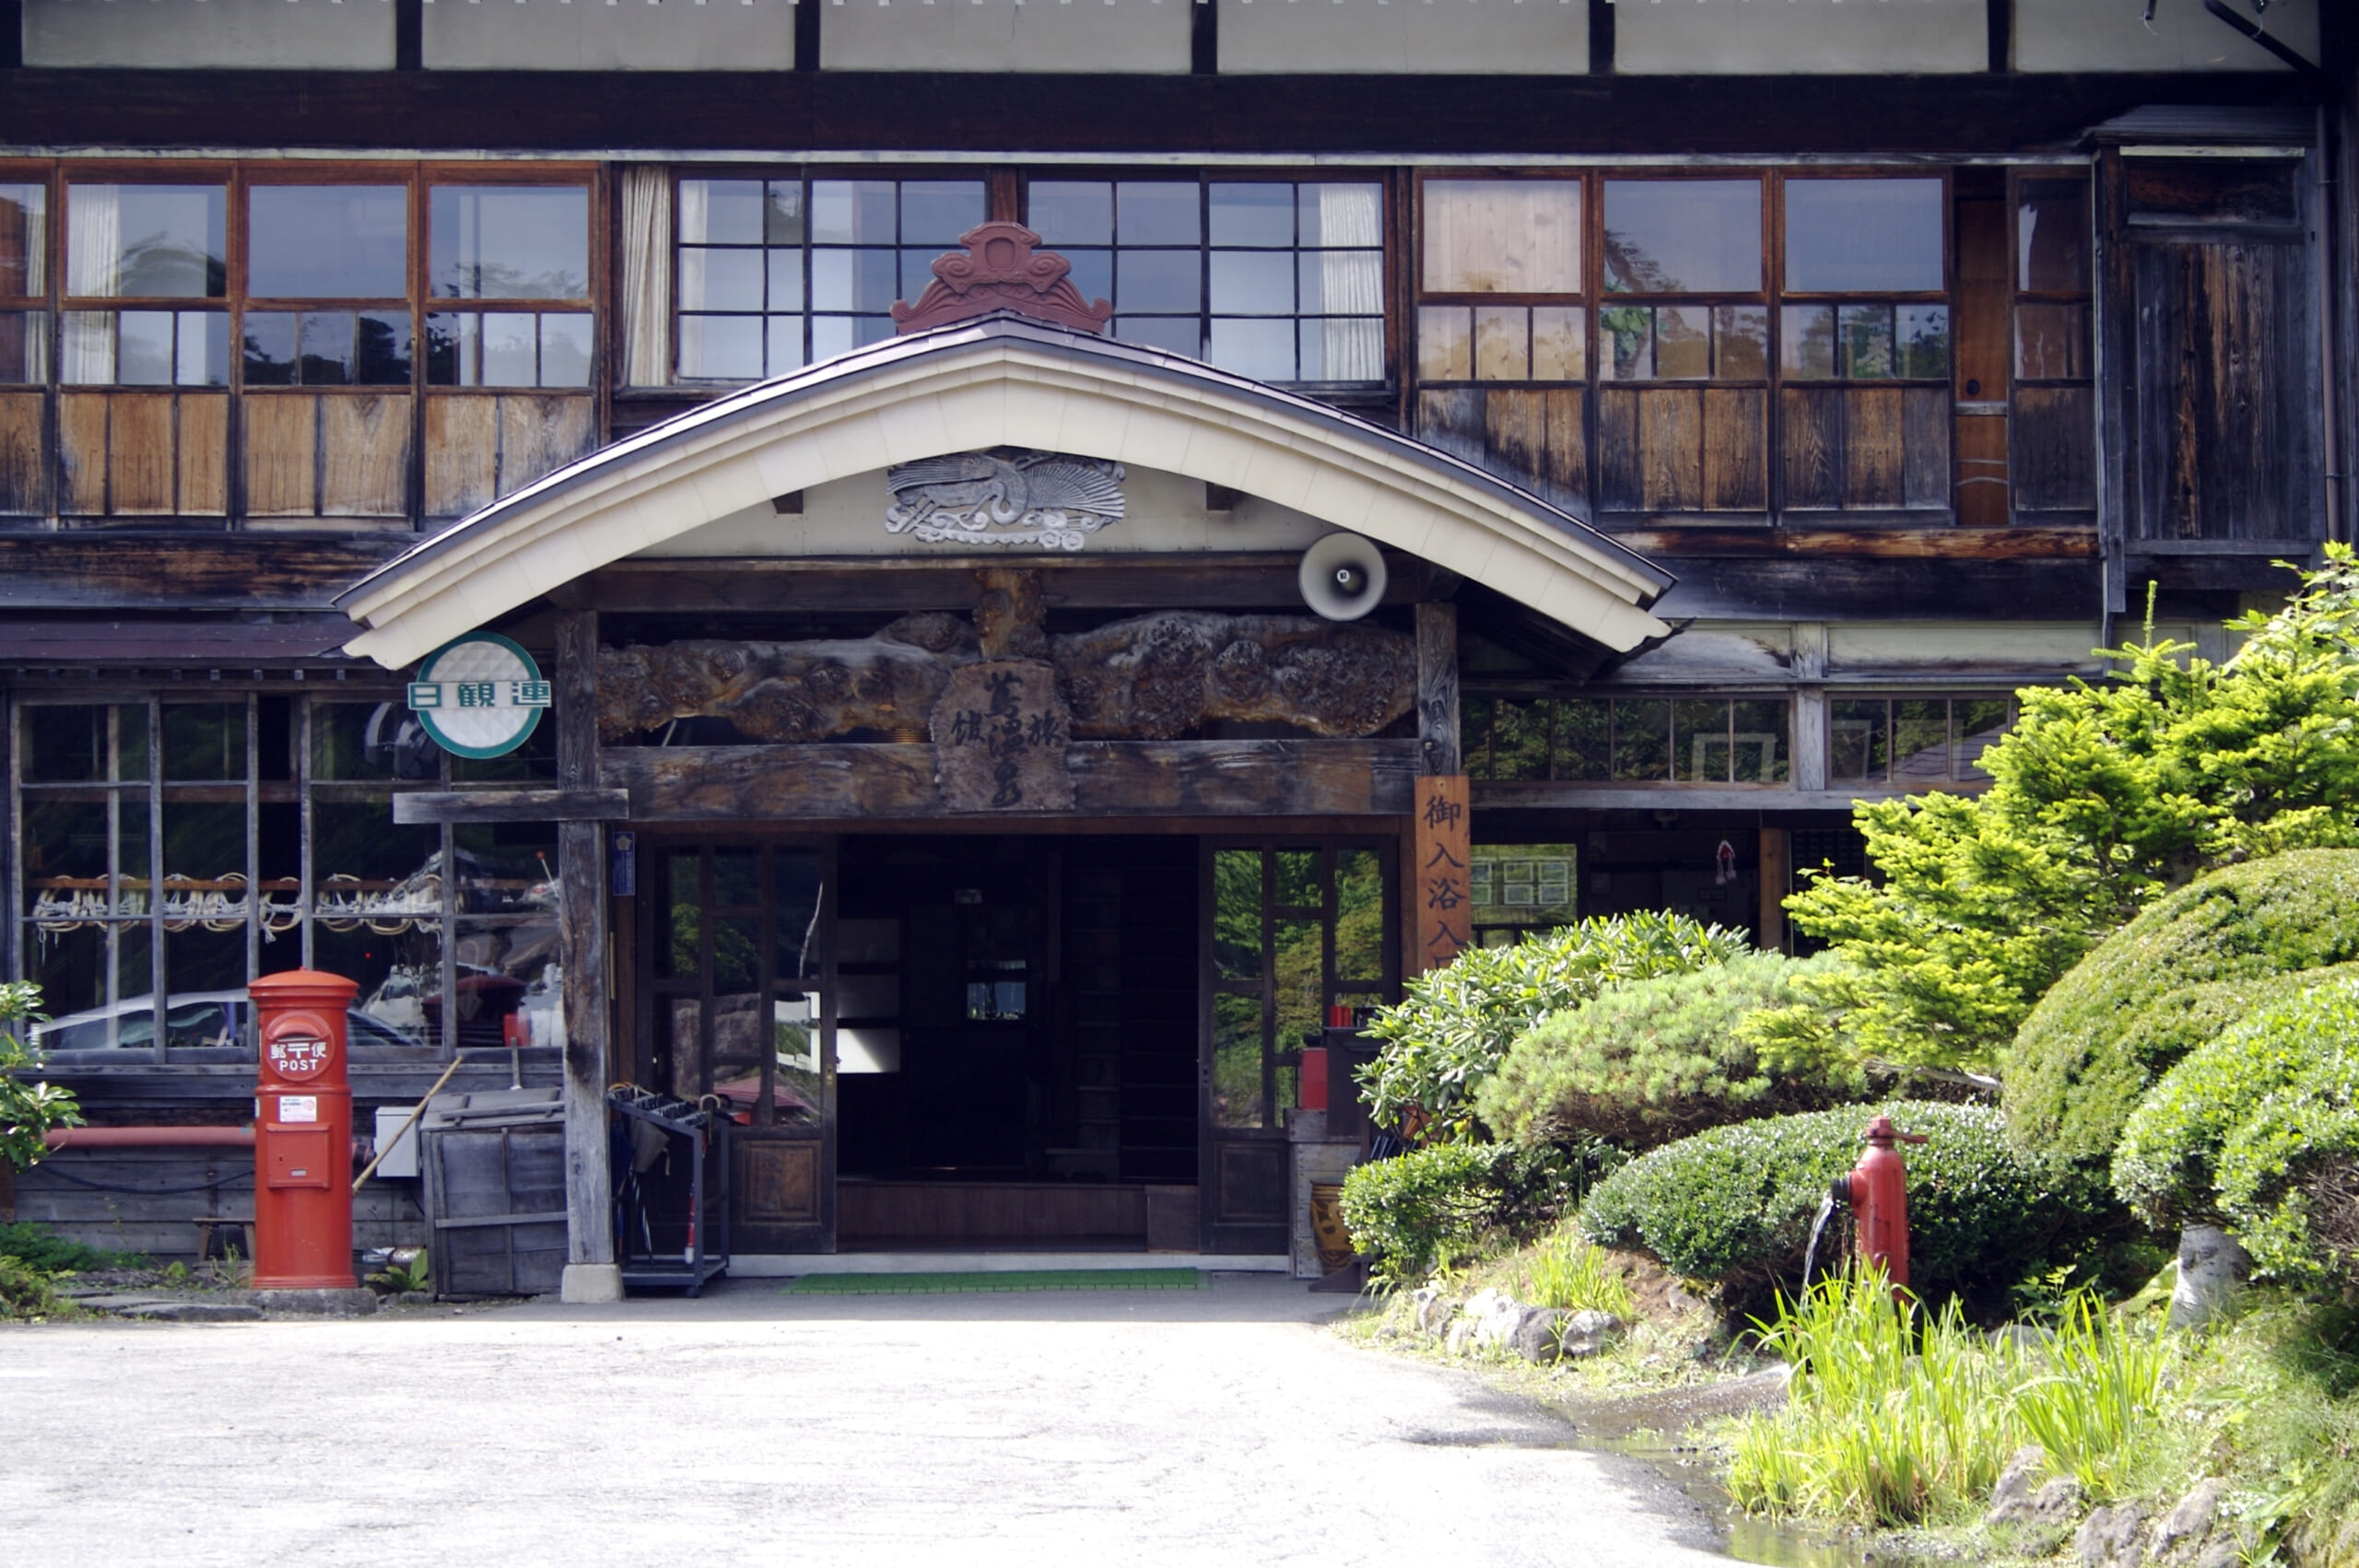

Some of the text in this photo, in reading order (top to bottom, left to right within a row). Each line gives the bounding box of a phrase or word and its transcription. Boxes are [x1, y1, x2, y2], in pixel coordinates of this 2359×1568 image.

[410, 682, 549, 708] 日観連
[279, 1059, 318, 1071] POST
